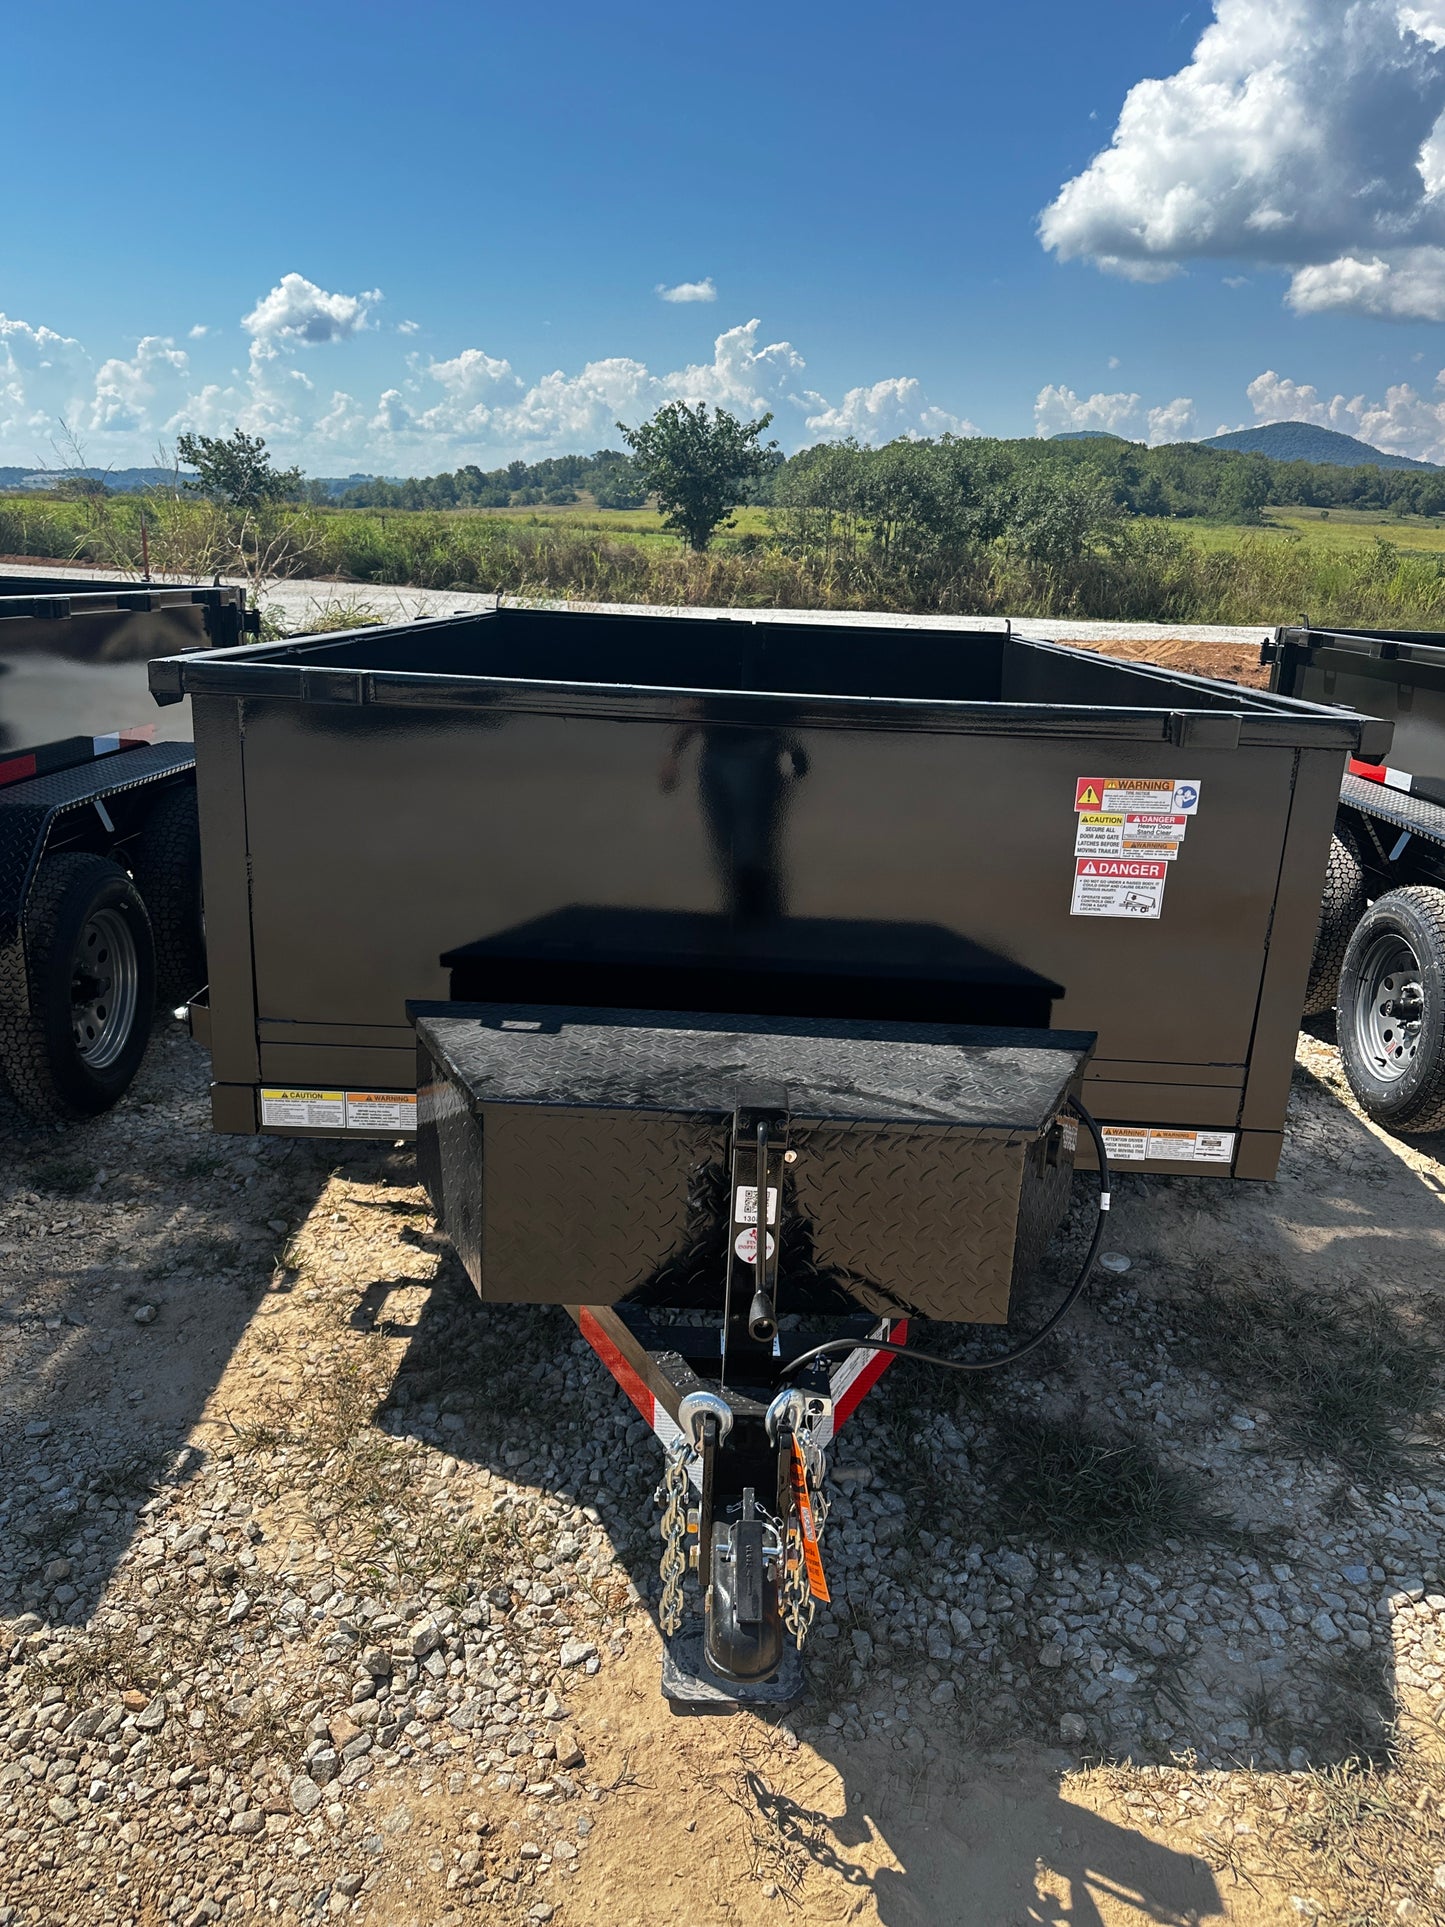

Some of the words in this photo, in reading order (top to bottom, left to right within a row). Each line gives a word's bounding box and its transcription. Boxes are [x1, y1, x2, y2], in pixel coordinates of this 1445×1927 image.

[1118, 781, 1169, 790] WARNING
[1089, 816, 1122, 824] CAUTION
[1142, 816, 1175, 824] DANGER
[1099, 863, 1159, 876] DANGER
